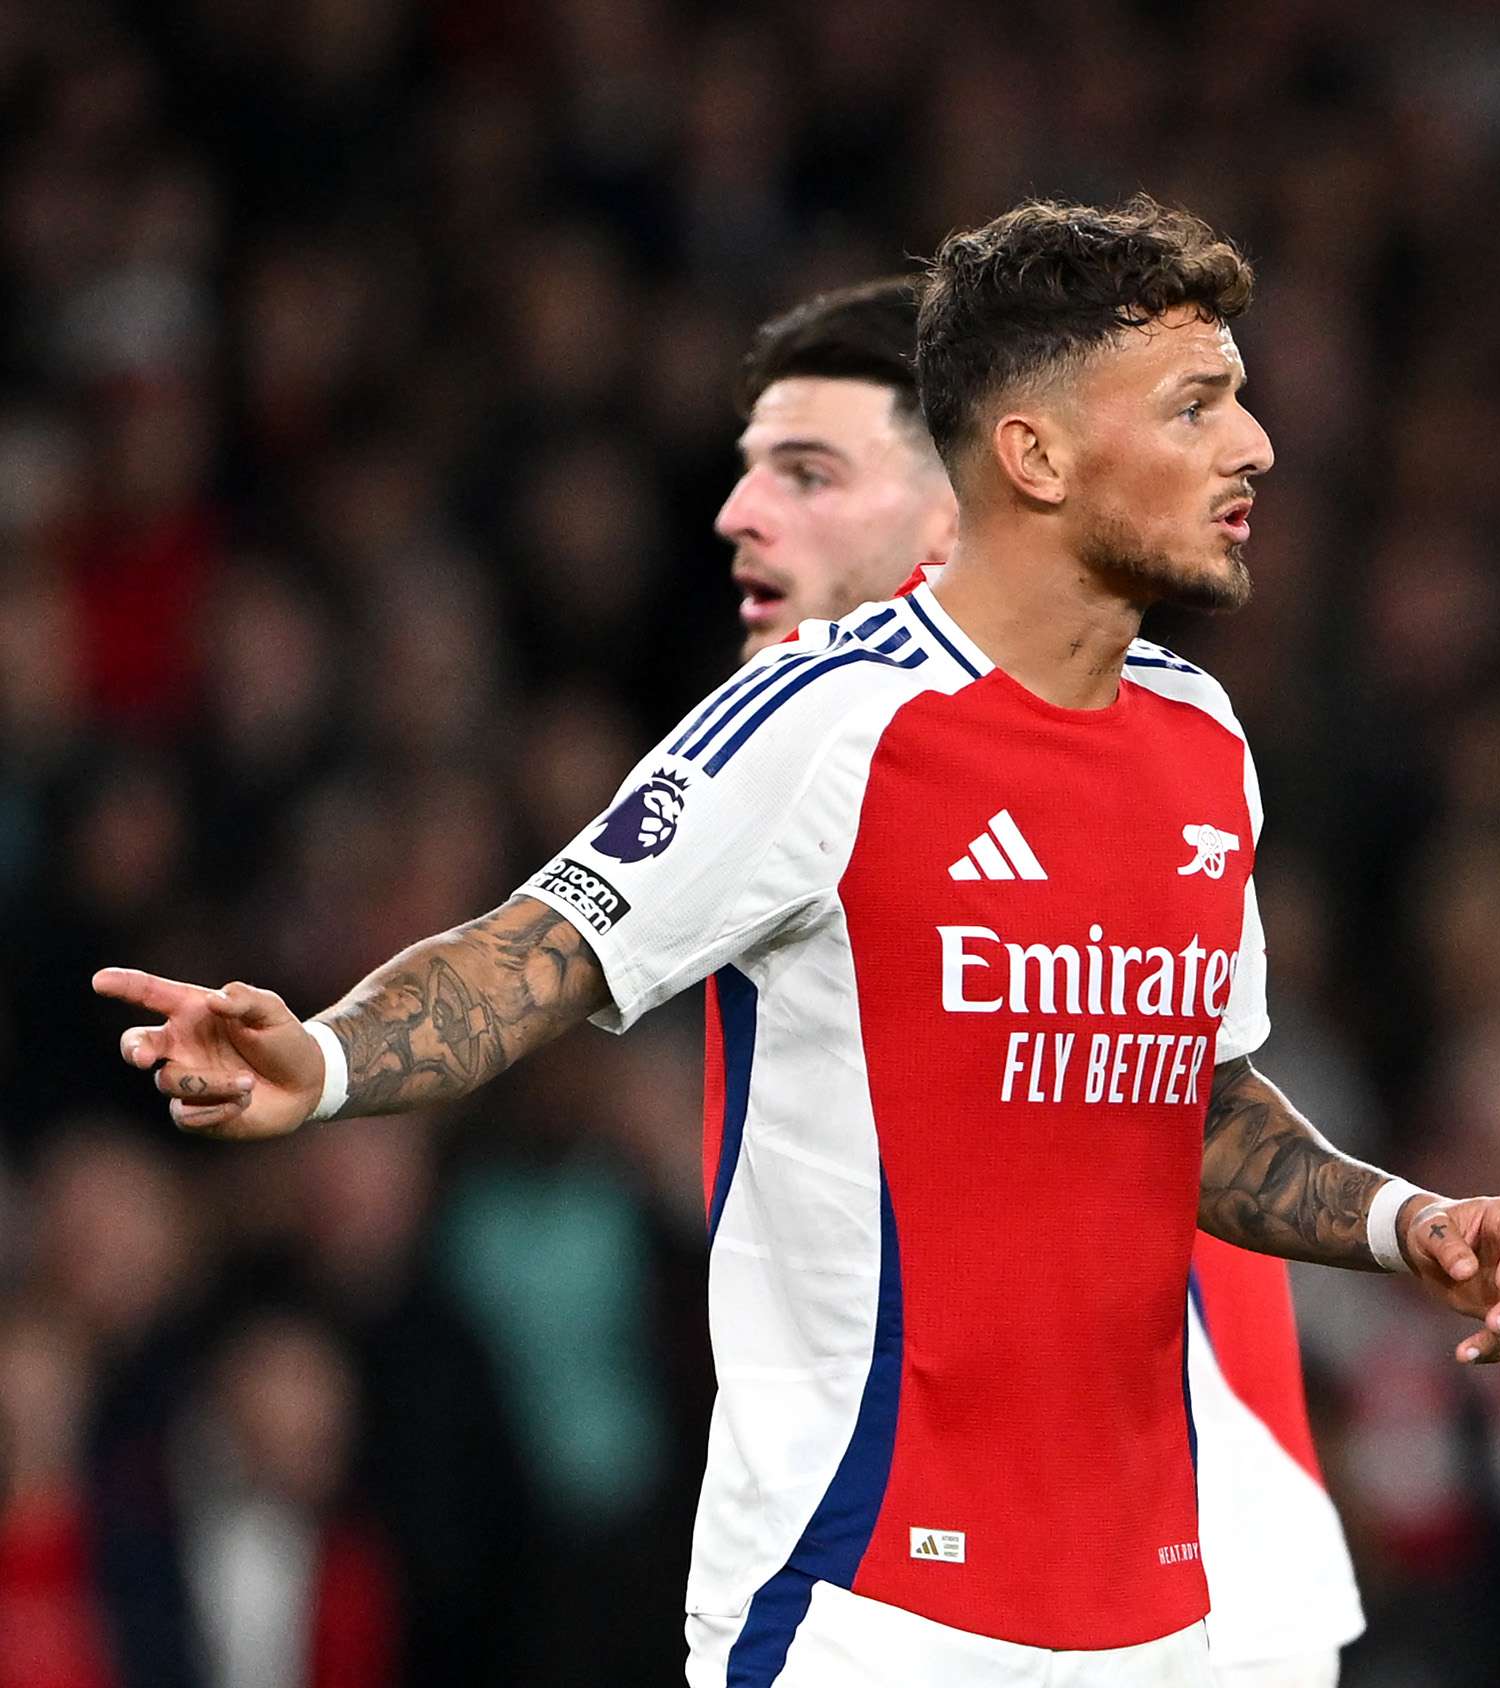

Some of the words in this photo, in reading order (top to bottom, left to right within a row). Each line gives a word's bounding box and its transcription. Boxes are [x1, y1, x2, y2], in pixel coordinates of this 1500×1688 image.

[545, 877, 612, 935] racism
[561, 865, 619, 913] room
[1001, 1032, 1075, 1102] FLY
[1084, 1034, 1207, 1105] BETTER
